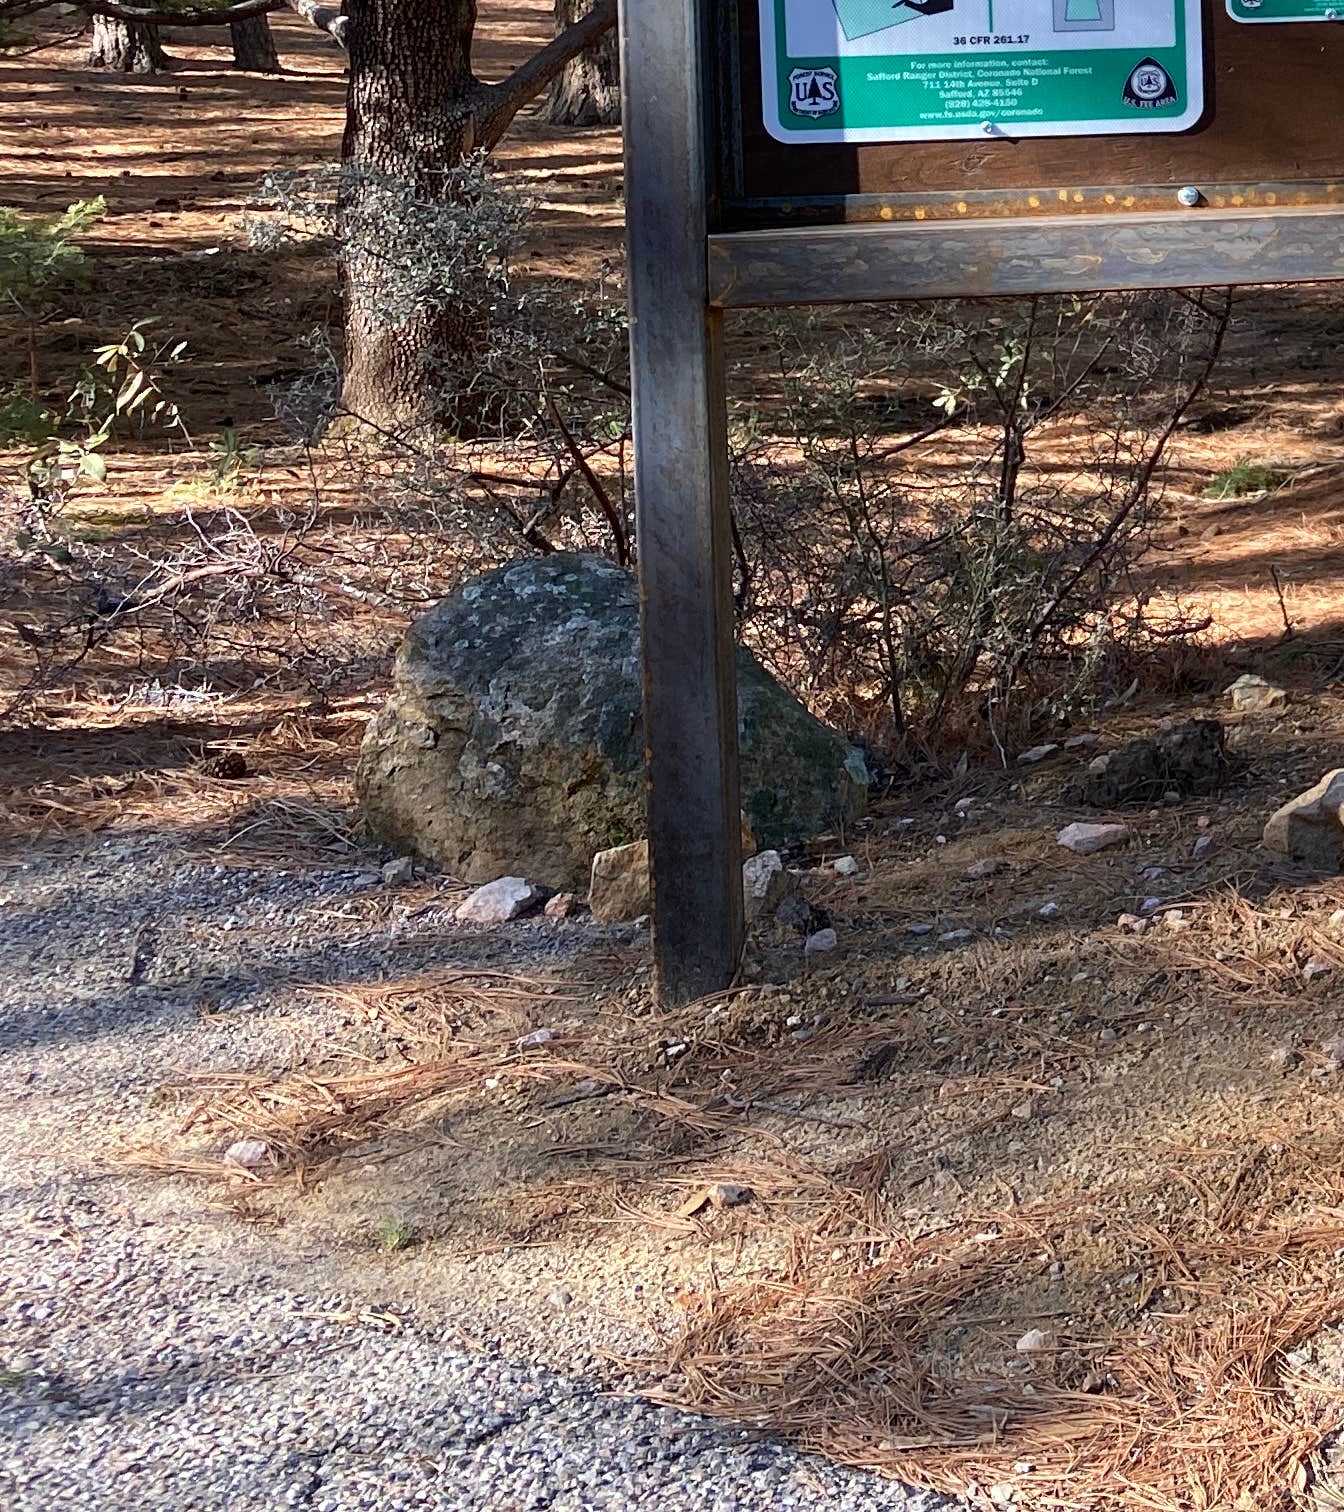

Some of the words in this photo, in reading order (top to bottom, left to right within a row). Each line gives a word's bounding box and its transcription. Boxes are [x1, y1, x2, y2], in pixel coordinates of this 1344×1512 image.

[969, 35, 991, 45] CFR
[993, 34, 1030, 44] 261.17
[910, 61, 926, 70] For
[928, 61, 952, 69] more
[903, 71, 936, 81] Ranger
[1023, 68, 1061, 76] National
[1063, 66, 1093, 76] Forest
